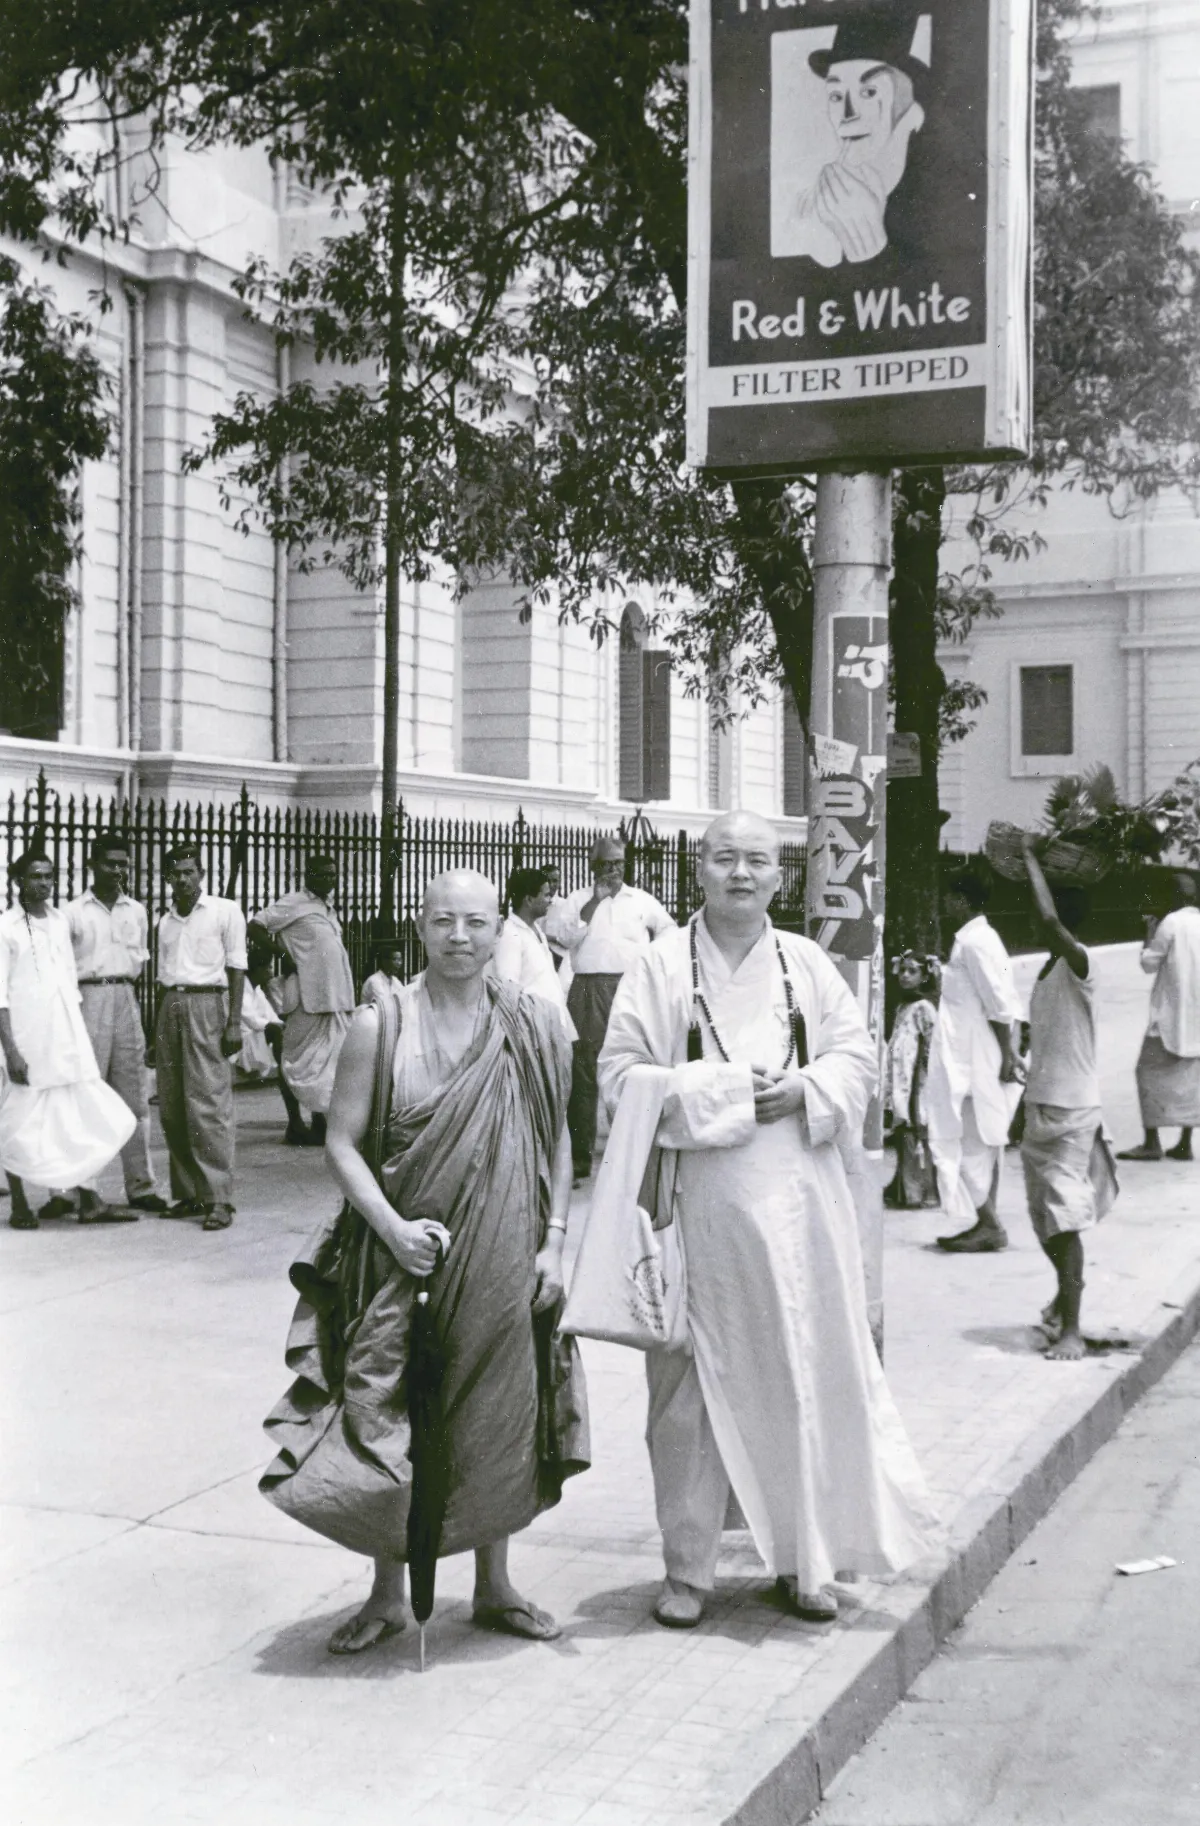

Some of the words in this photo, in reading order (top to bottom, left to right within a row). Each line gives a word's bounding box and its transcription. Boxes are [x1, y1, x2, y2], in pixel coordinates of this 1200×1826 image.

[732, 297, 805, 342] Red
[819, 300, 846, 335] &
[853, 281, 971, 332] White
[732, 367, 842, 397] FILTER
[854, 356, 969, 388] TIPPED
